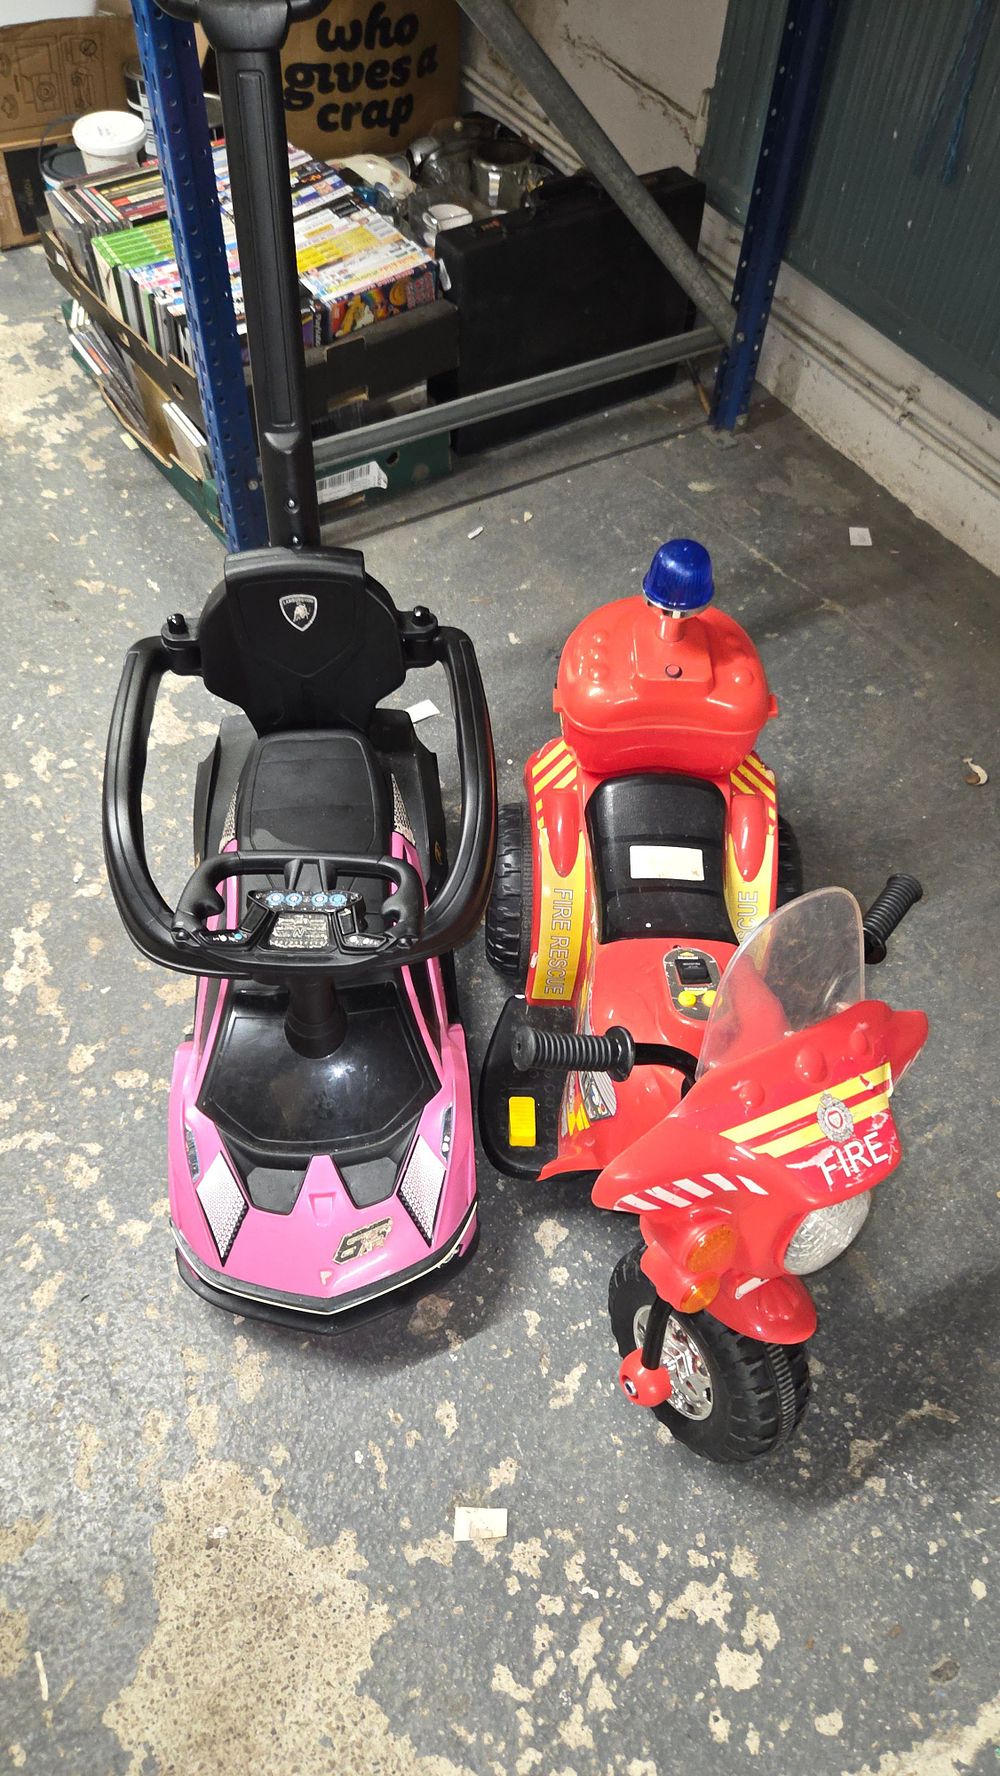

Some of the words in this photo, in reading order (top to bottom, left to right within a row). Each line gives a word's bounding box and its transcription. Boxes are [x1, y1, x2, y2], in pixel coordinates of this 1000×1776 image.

[316, 1, 419, 52] who
[284, 55, 412, 111] gives
[417, 44, 439, 78] a
[316, 93, 414, 137] crap
[552, 888, 574, 931] FIRE
[544, 935, 570, 995] RESCUE
[819, 1131, 889, 1187] FIRE
